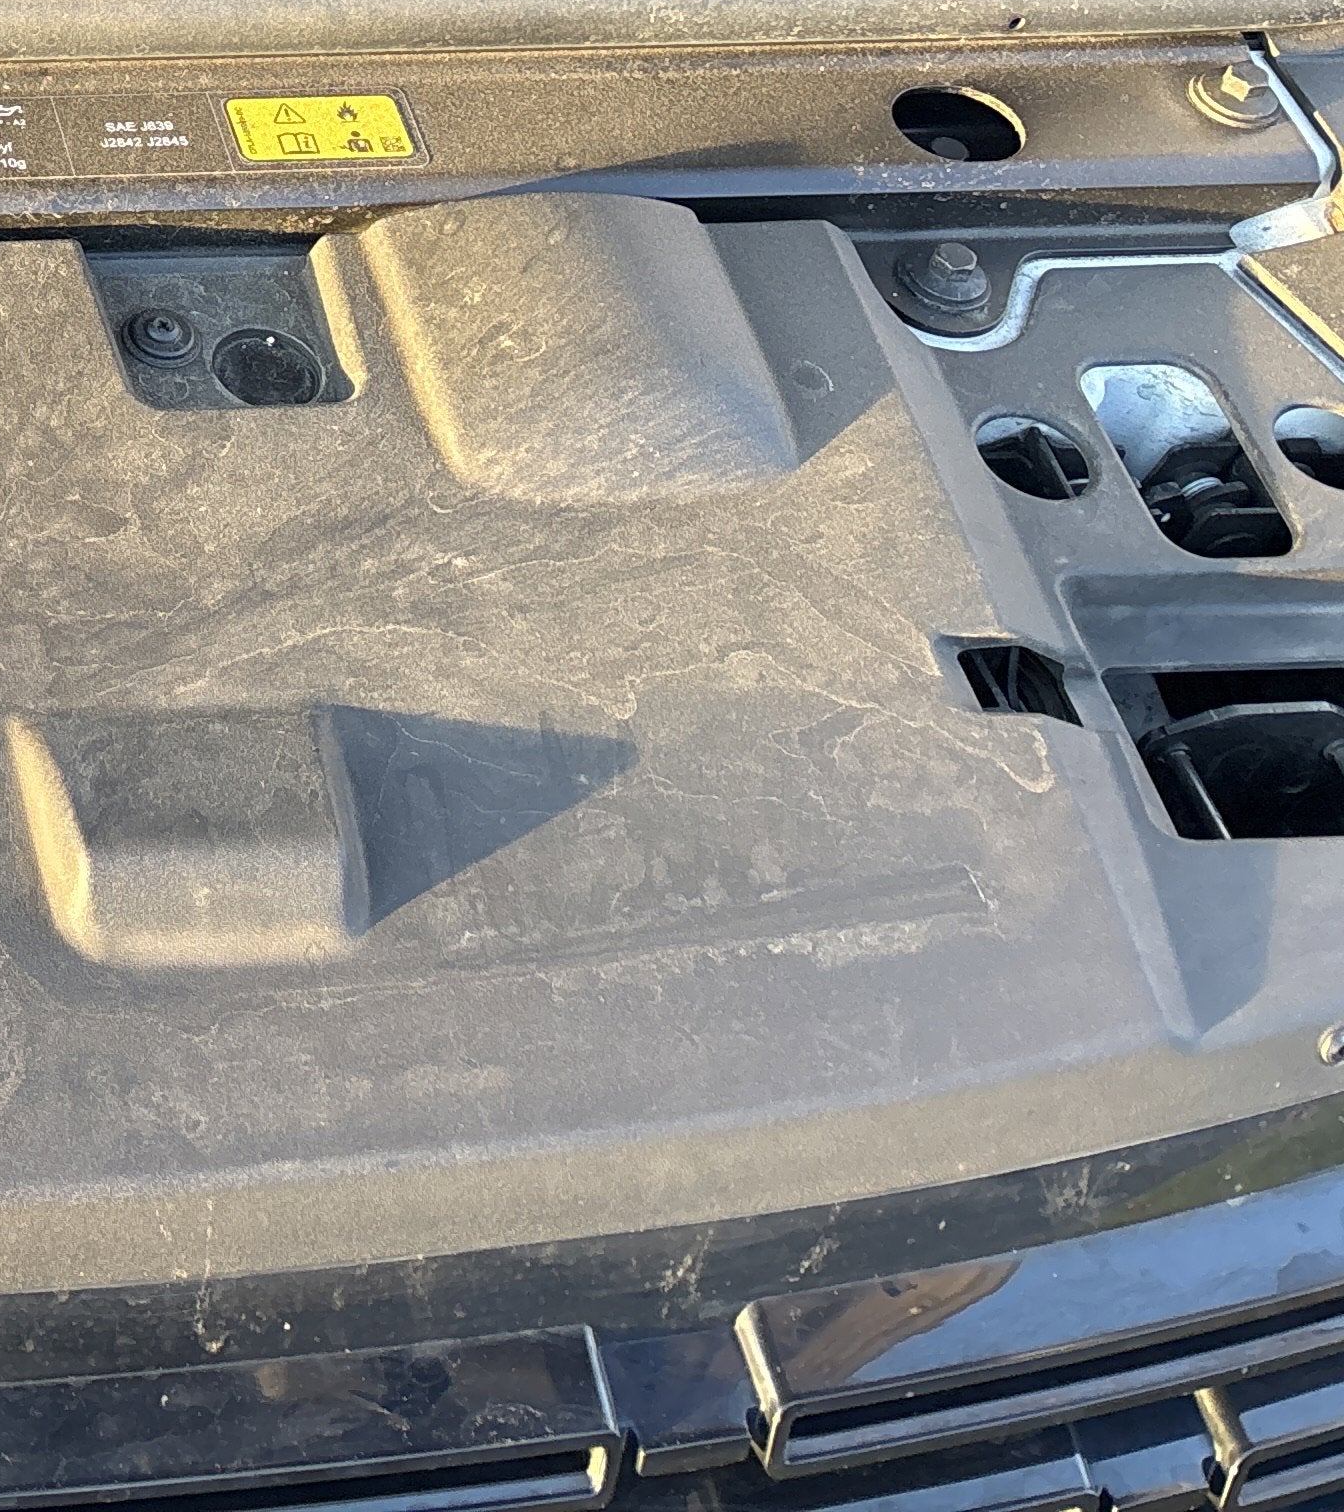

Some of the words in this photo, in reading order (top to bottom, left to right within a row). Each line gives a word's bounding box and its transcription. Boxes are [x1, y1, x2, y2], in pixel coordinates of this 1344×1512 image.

[104, 121, 138, 133] SAE
[99, 137, 144, 148] J2842
[146, 135, 189, 147] J2845
